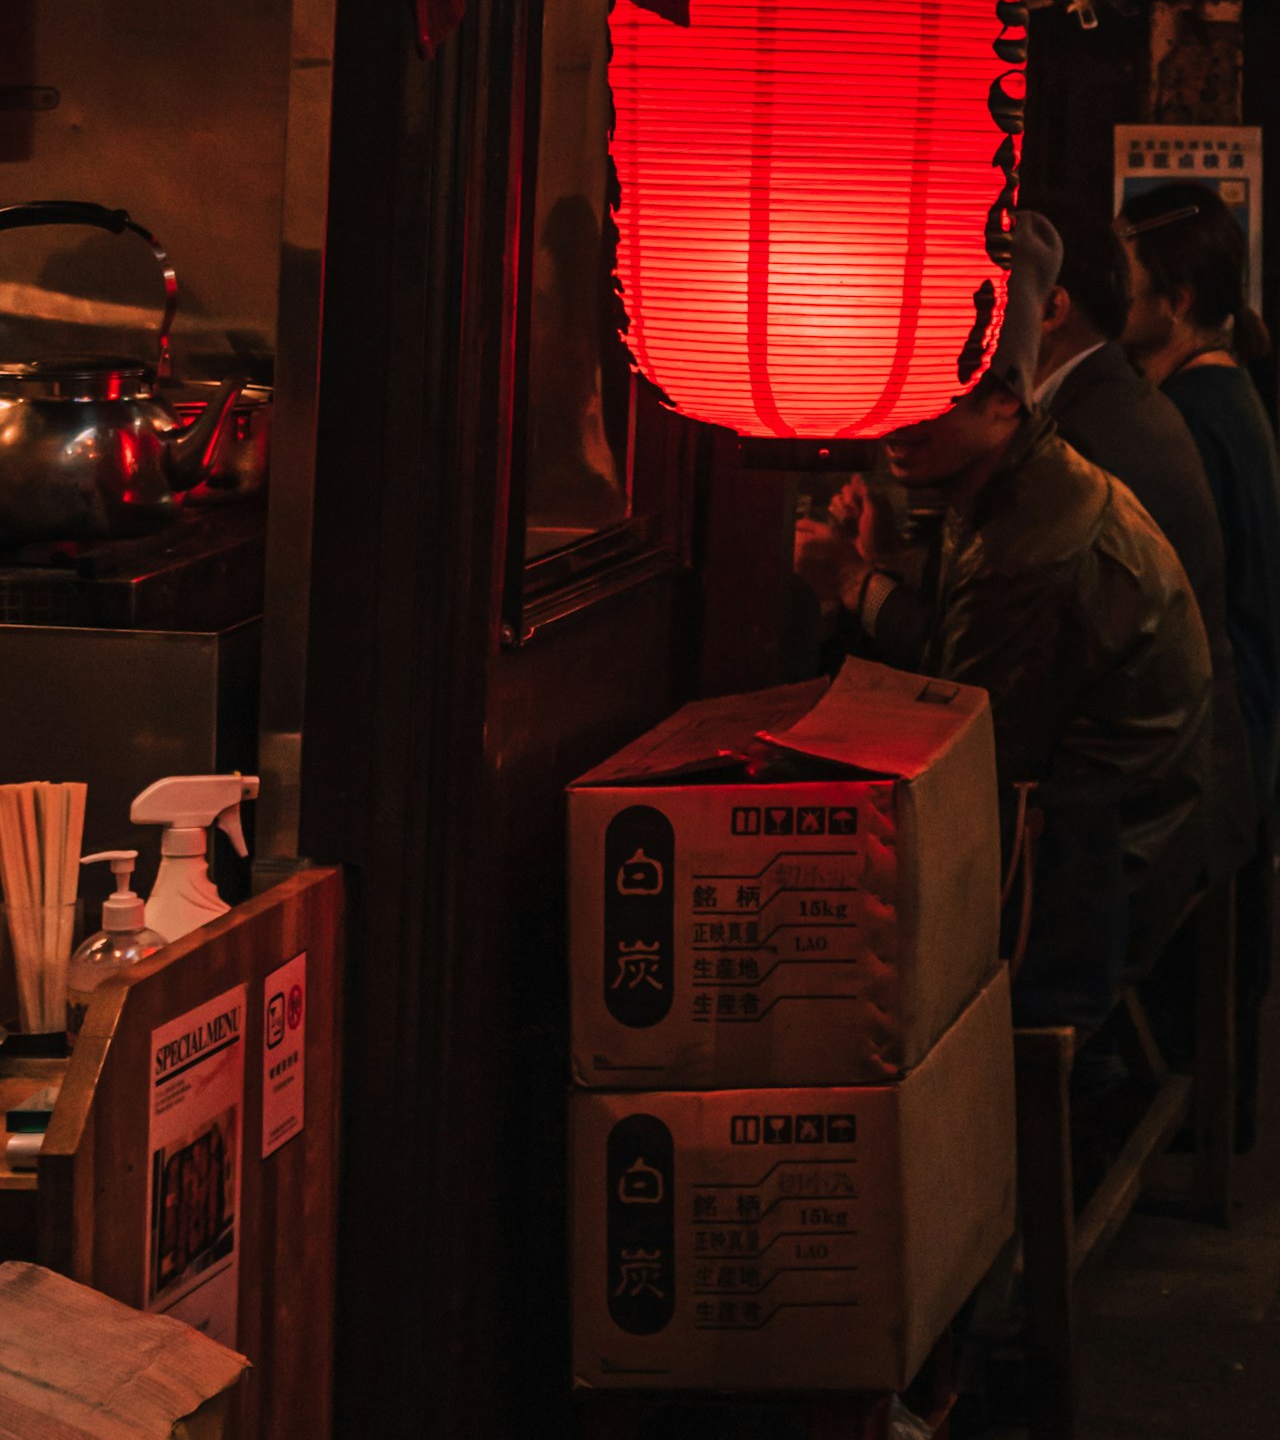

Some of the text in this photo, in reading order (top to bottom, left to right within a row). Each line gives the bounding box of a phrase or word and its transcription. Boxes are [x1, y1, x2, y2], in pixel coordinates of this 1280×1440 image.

[692, 884, 761, 908] 銘柄
[610, 846, 665, 991] 白炭
[799, 899, 849, 920] 15kg
[796, 936, 828, 952] LAO
[692, 957, 760, 981] 生産地
[692, 993, 760, 1015] 生産者
[155, 1025, 208, 1075] SPECIAL
[614, 1155, 666, 1300] 白炭
[799, 1207, 849, 1228] 15kg
[796, 1244, 829, 1260] LAO
[695, 1265, 760, 1288] 生産地
